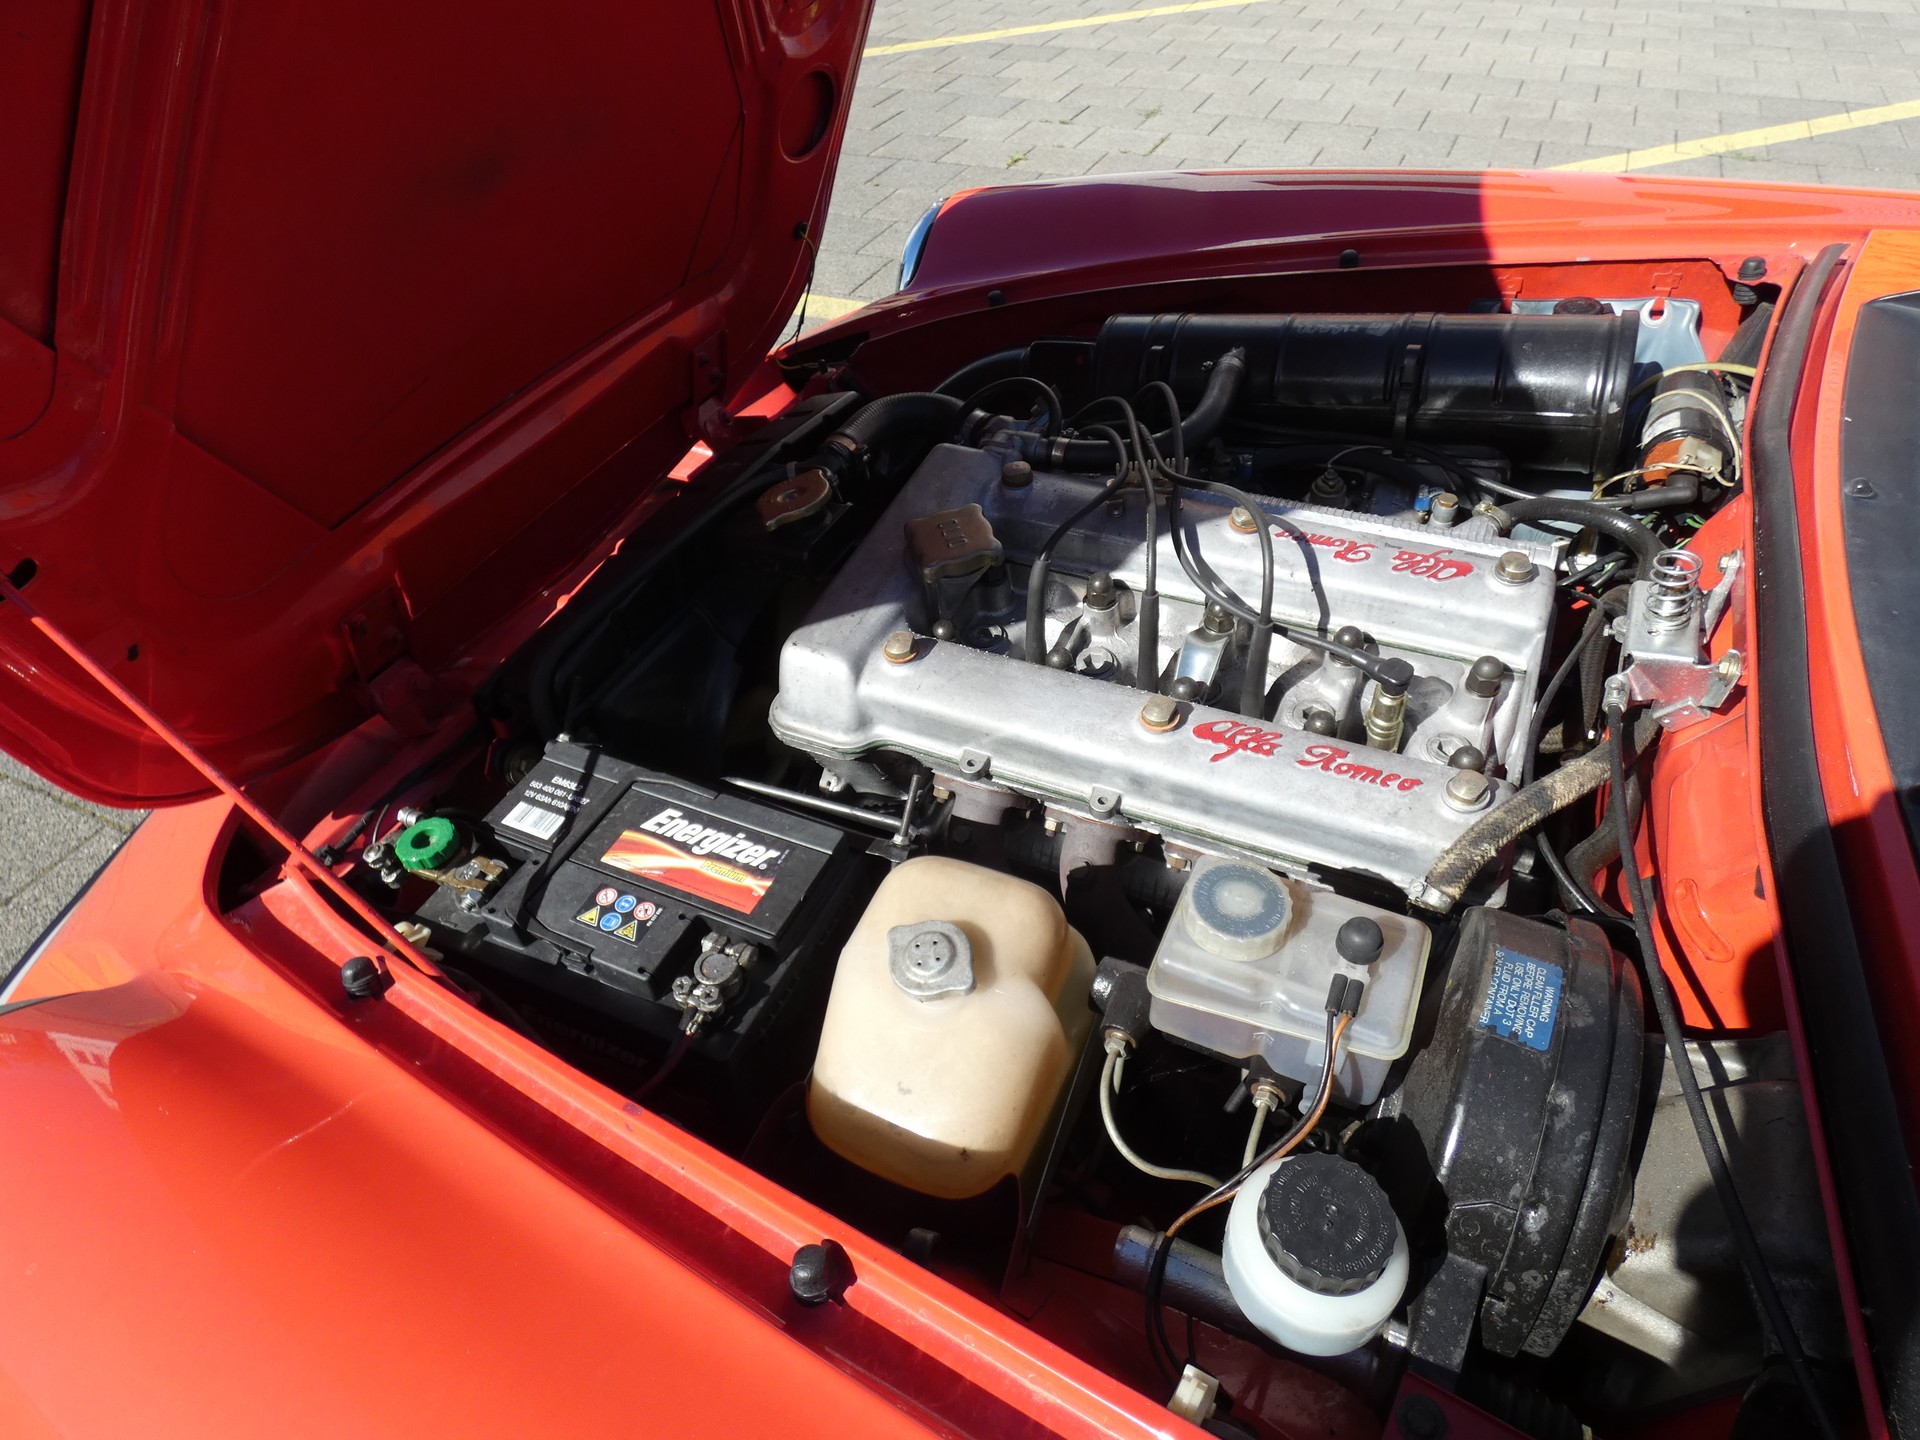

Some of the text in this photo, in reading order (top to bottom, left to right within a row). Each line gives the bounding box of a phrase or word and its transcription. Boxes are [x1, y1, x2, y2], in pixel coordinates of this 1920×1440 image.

[1273, 529, 1474, 581] Alfa Romeo
[1192, 719, 1424, 791] Alfa Romeo
[524, 789, 537, 798] 12V
[535, 794, 552, 804] 63Ah
[542, 785, 555, 794] 400
[639, 807, 781, 867] Energizer
[700, 860, 748, 883] Premium
[1502, 962, 1514, 982] FLUID
[1502, 962, 1525, 1026] USE ONLY DOT 3
[1479, 977, 1499, 1023] CONTAINER
[1496, 983, 1509, 1008] FROM
[1512, 962, 1536, 1035] BEFORE REMOVING
[1524, 967, 1547, 1038] CLEAN FILLER CAP
[1539, 986, 1555, 1023] WARNING
